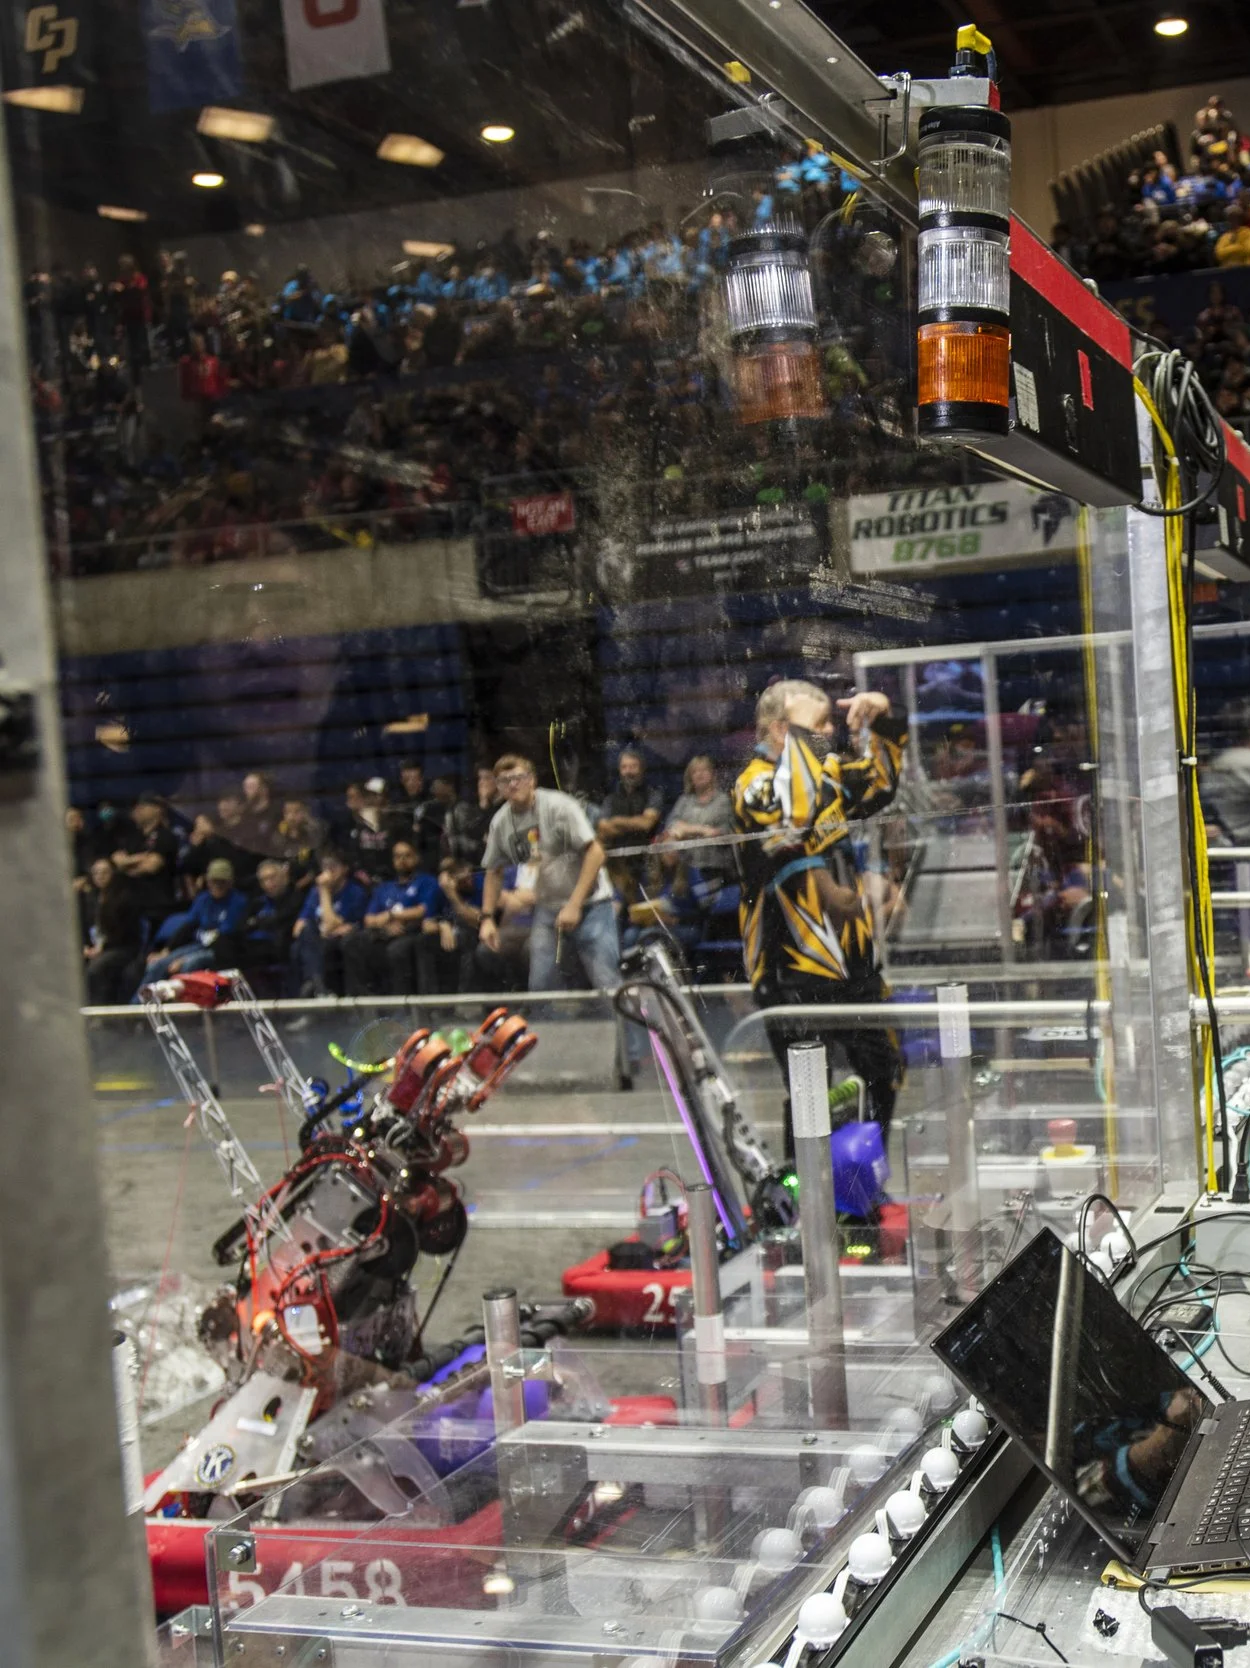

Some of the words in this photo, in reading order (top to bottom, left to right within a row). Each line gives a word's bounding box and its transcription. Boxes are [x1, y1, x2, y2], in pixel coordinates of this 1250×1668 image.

[516, 501, 545, 519] NOT
[547, 499, 566, 514] AN
[887, 485, 982, 512] TITAN
[853, 501, 1010, 540] ROBOTICS
[892, 532, 982, 563] 8768
